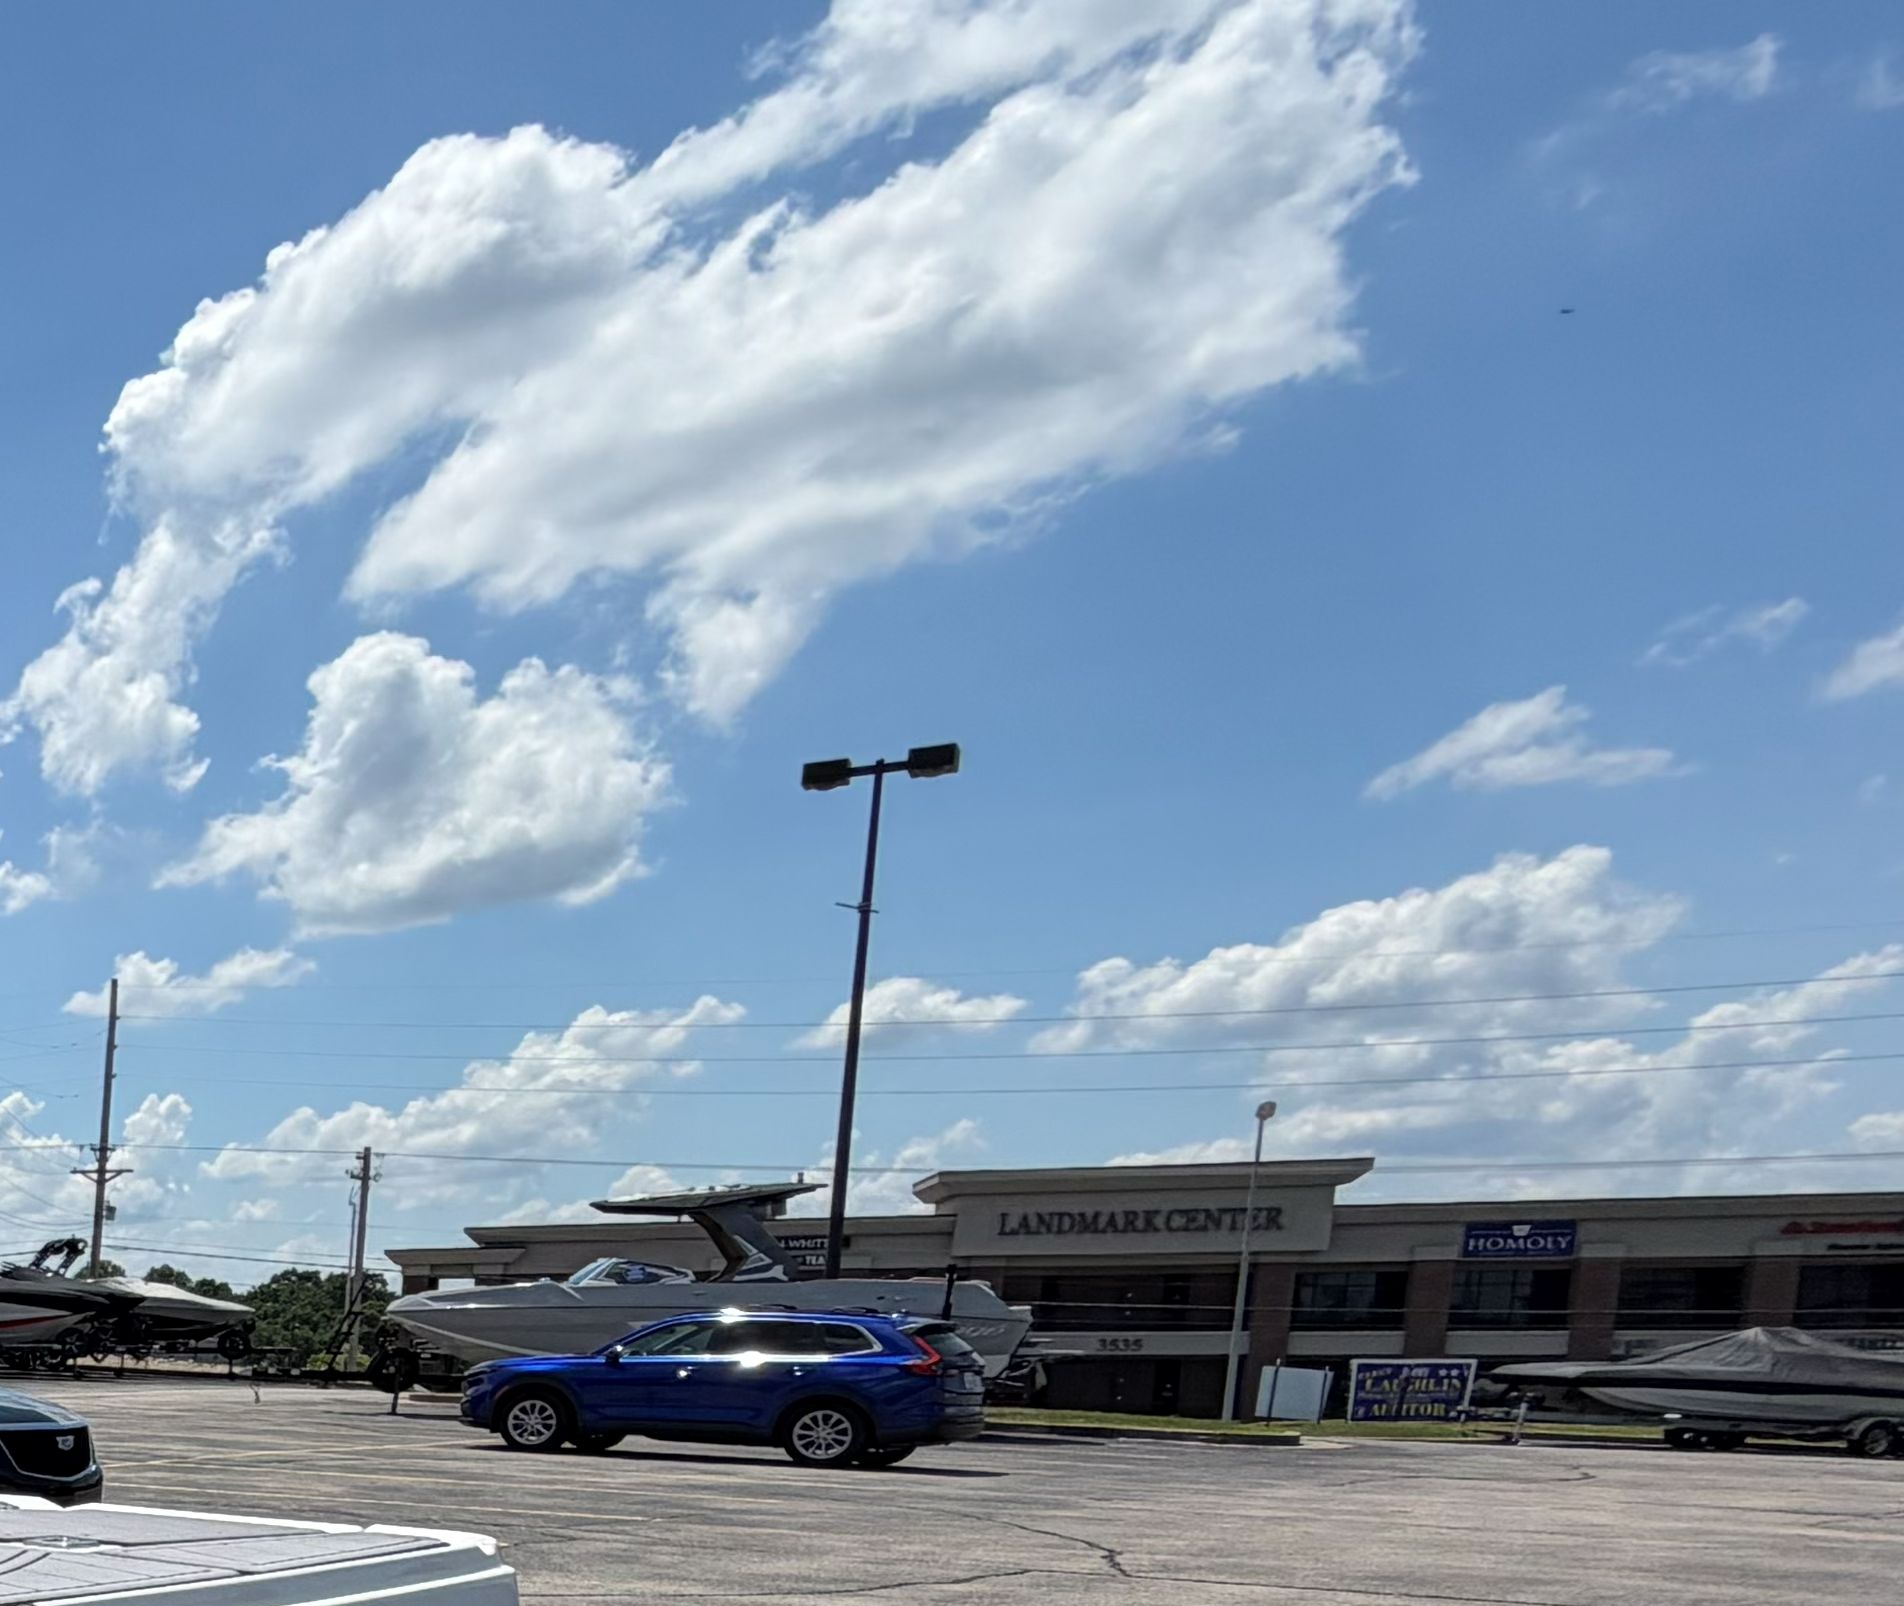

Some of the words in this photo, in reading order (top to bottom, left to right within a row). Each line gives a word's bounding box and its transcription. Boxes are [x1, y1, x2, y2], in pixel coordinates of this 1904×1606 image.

[997, 1211, 1162, 1236] LANDMARK
[1164, 1206, 1284, 1232] CENTER
[1467, 1235, 1572, 1251] HOMOLY
[805, 1256, 826, 1265] TEA
